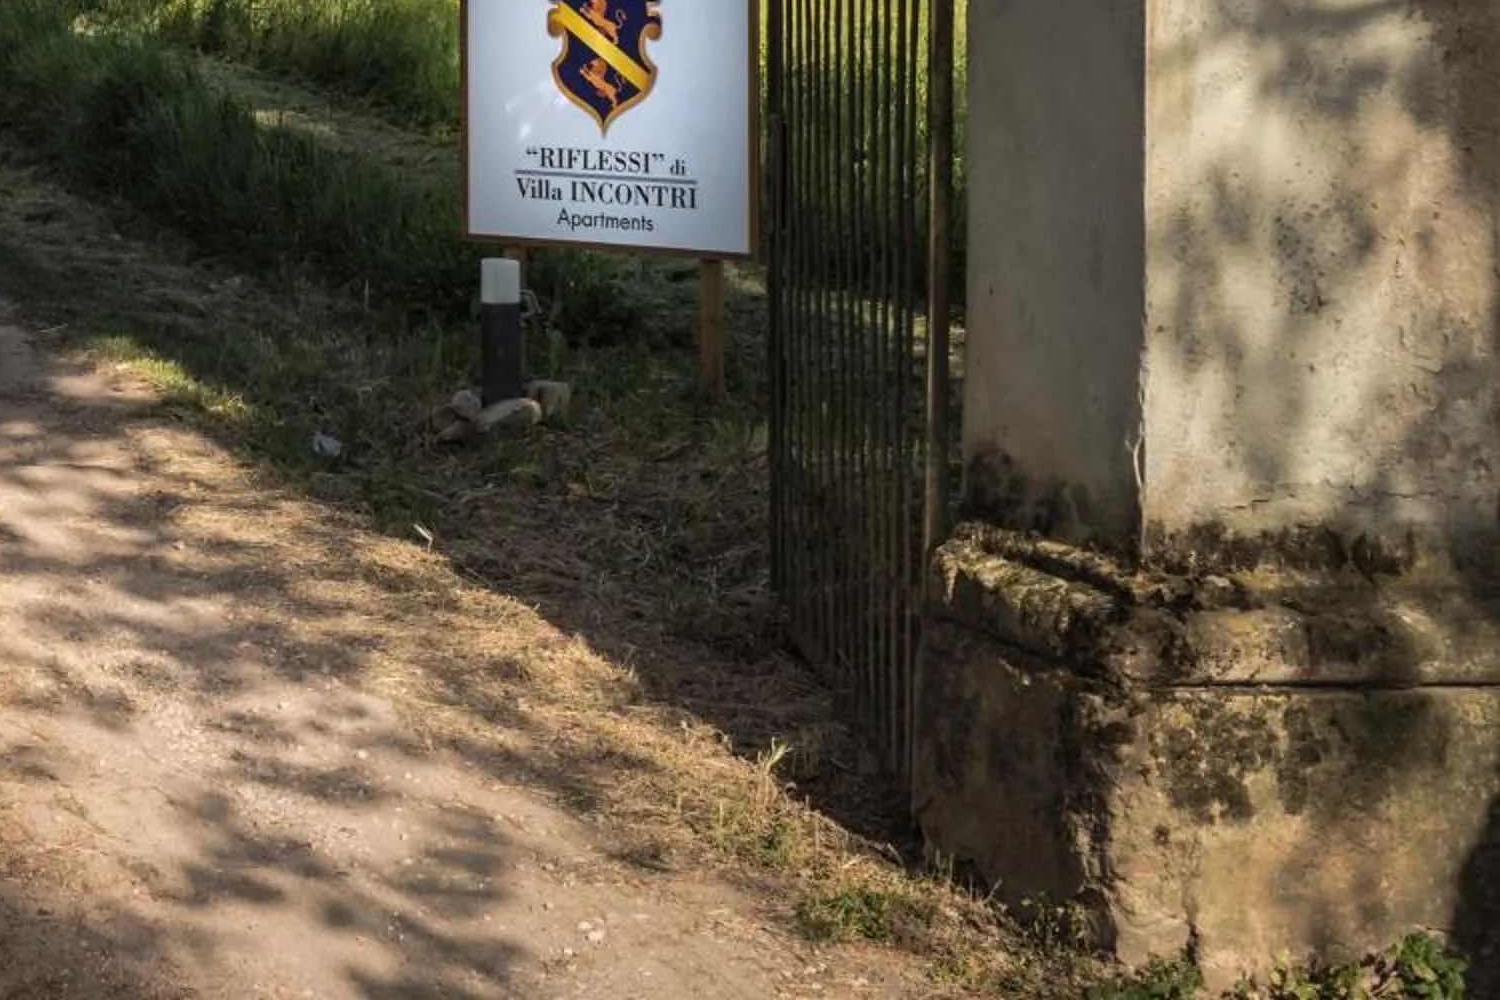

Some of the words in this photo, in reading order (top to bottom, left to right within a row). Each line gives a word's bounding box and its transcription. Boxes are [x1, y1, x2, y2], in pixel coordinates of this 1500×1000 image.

[669, 159, 687, 176] di
[516, 177, 563, 201] Villa
[571, 181, 697, 209] INCONTRI
[557, 207, 654, 232] Apartments
